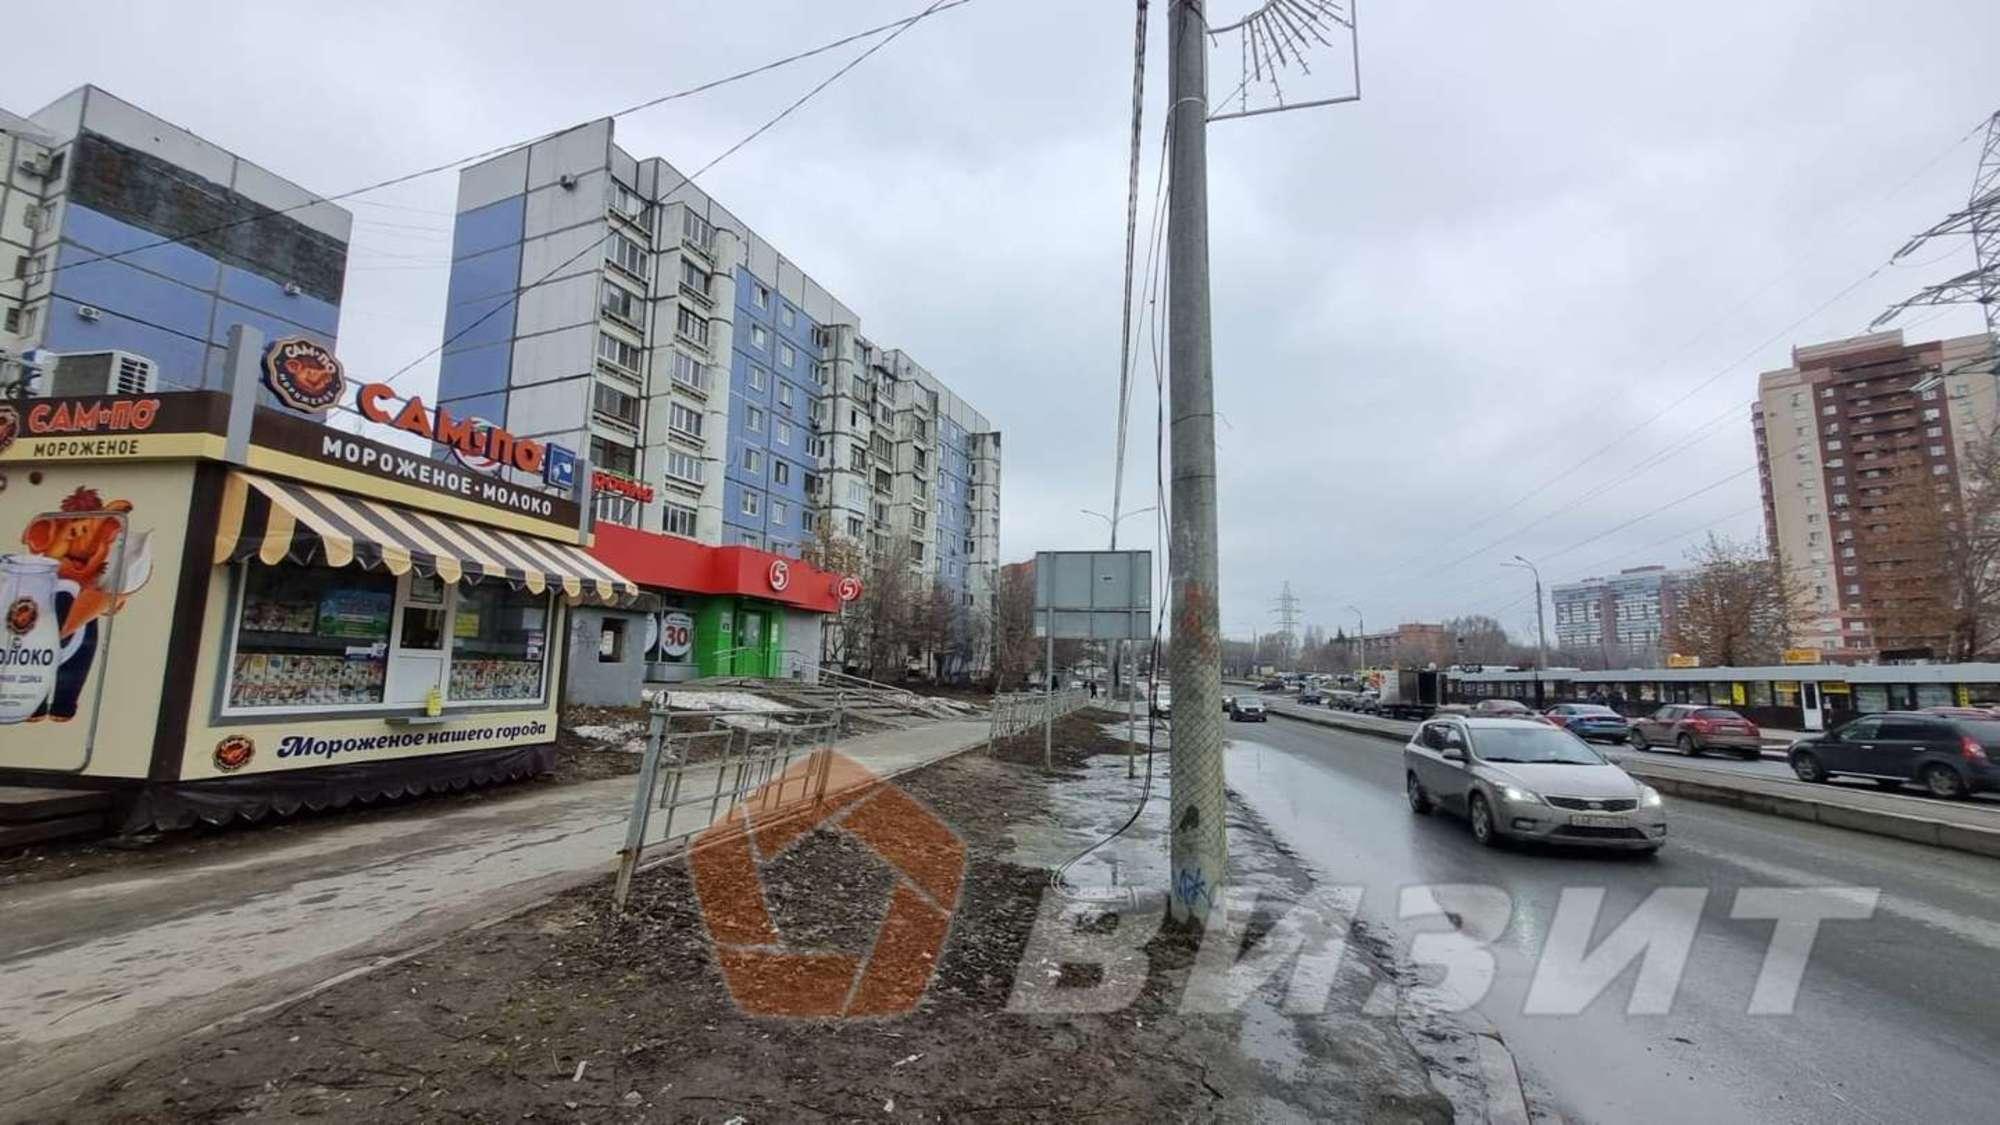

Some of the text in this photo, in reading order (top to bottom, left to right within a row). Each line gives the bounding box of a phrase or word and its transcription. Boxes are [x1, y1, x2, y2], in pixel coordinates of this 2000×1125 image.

[34, 440, 139, 456] МОРОЖЕНОЕ
[483, 483, 553, 517] МОЛОКО
[665, 625, 688, 647] 30
[277, 721, 546, 758] Мороженое нашего города
